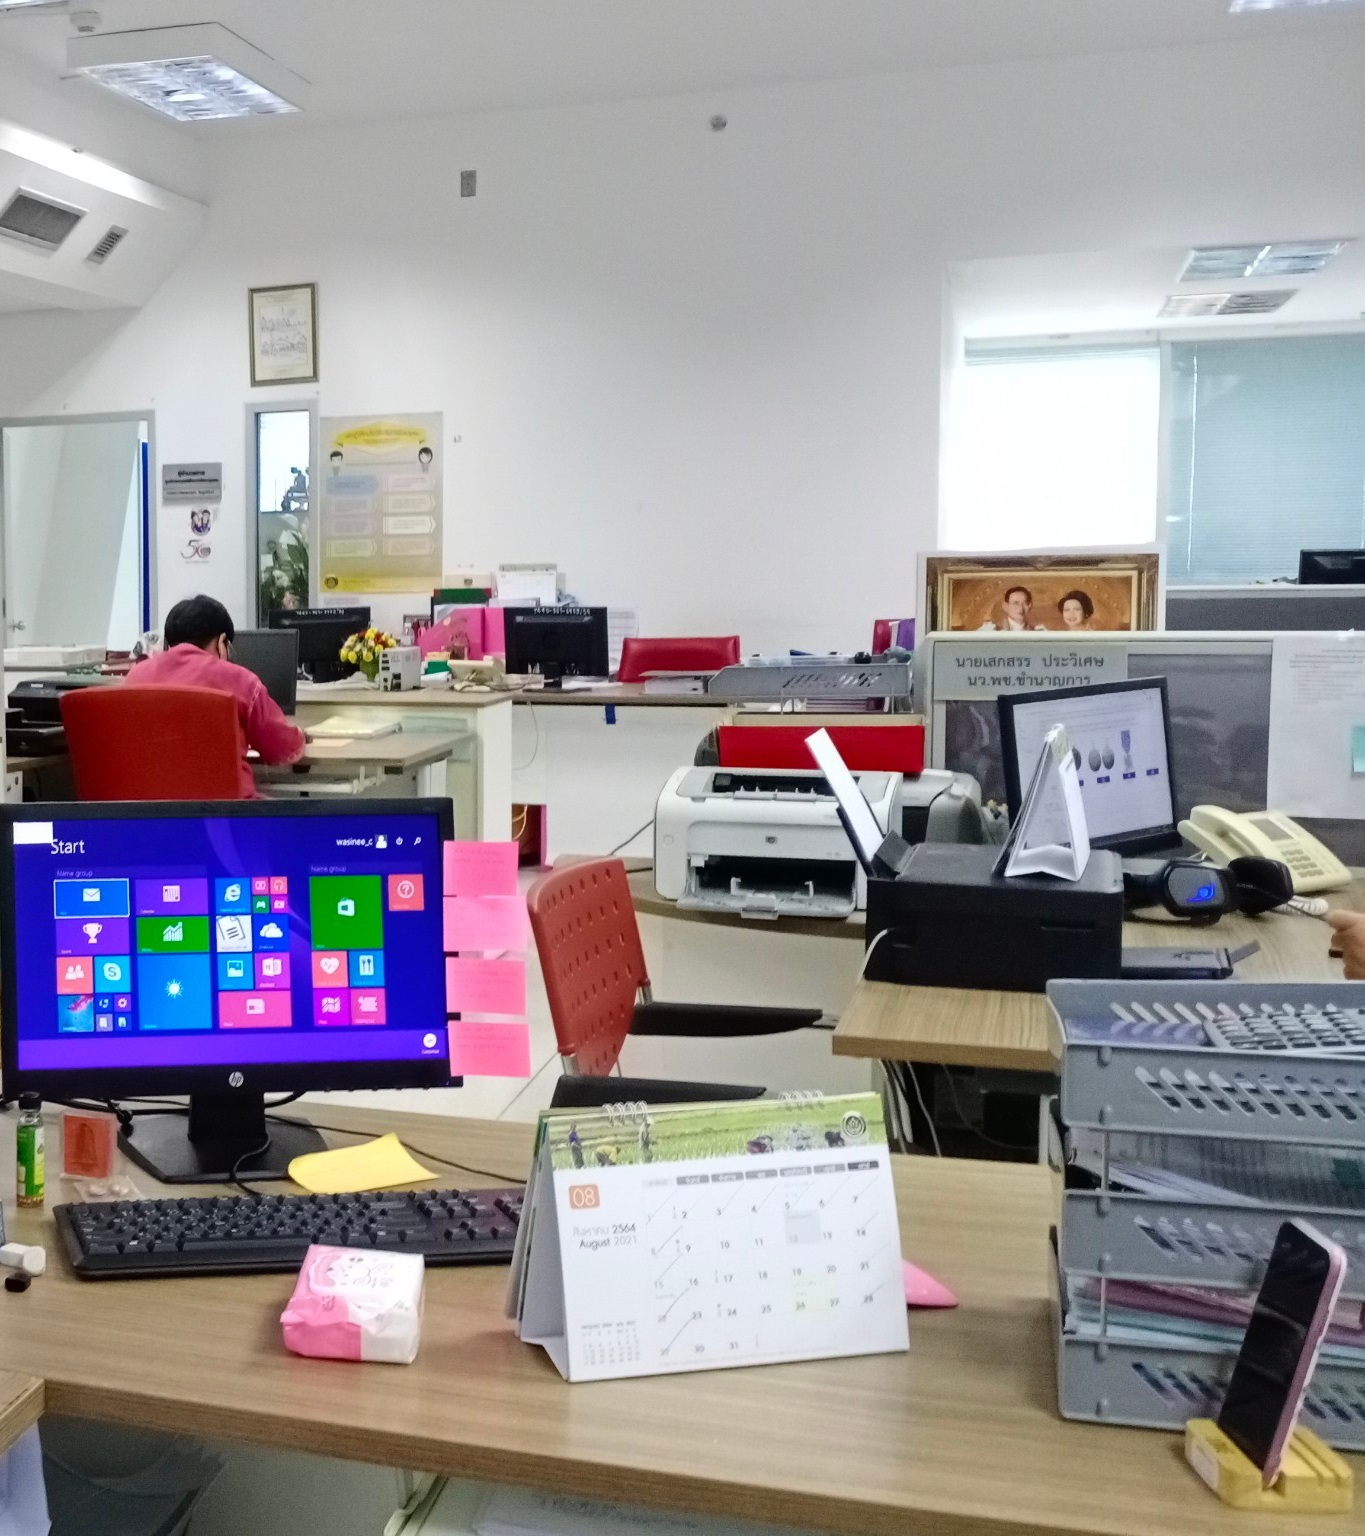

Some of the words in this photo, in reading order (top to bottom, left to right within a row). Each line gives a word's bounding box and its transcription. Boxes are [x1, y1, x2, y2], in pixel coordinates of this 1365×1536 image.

[956, 656, 1031, 668] นายเสกสรร
[1042, 653, 1105, 668] ประวิเศษ
[51, 839, 85, 854] Start
[572, 1187, 596, 1207] 08
[612, 1223, 636, 1234] 2564
[579, 1238, 611, 1250] August
